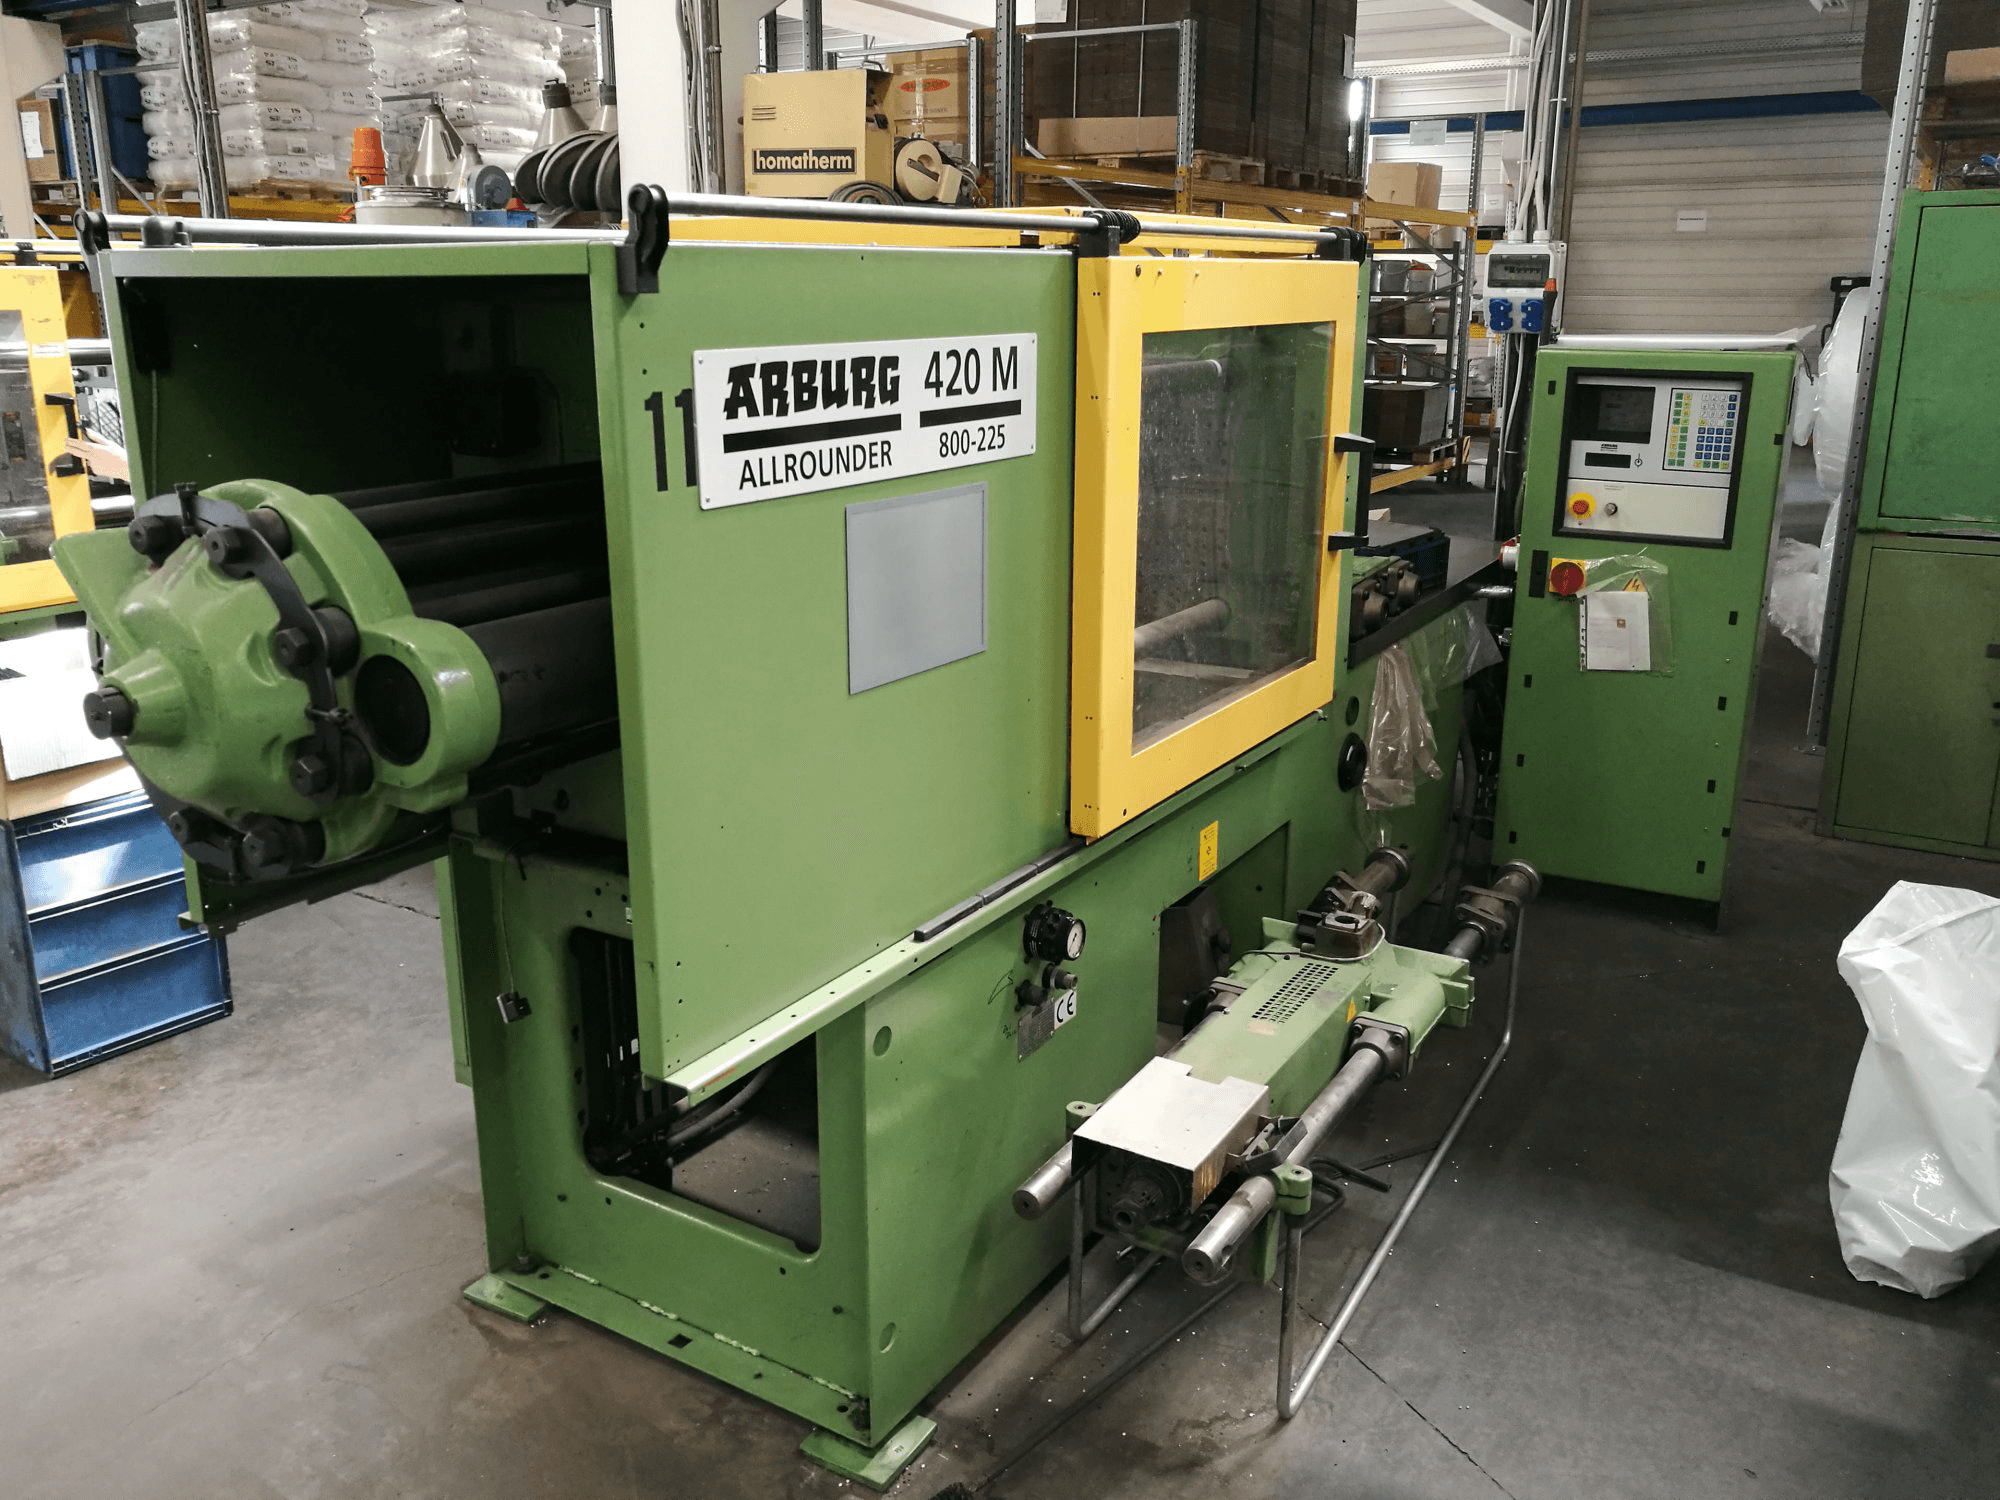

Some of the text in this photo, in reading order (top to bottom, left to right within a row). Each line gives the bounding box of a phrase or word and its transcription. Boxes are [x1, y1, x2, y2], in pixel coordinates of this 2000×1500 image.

[756, 148, 852, 170] homatherm
[723, 355, 900, 420] ARBURG
[924, 345, 1018, 398] 420 M
[644, 388, 697, 492] 11
[738, 439, 893, 490] ALLROUNDER
[938, 423, 1006, 458] 800-225
